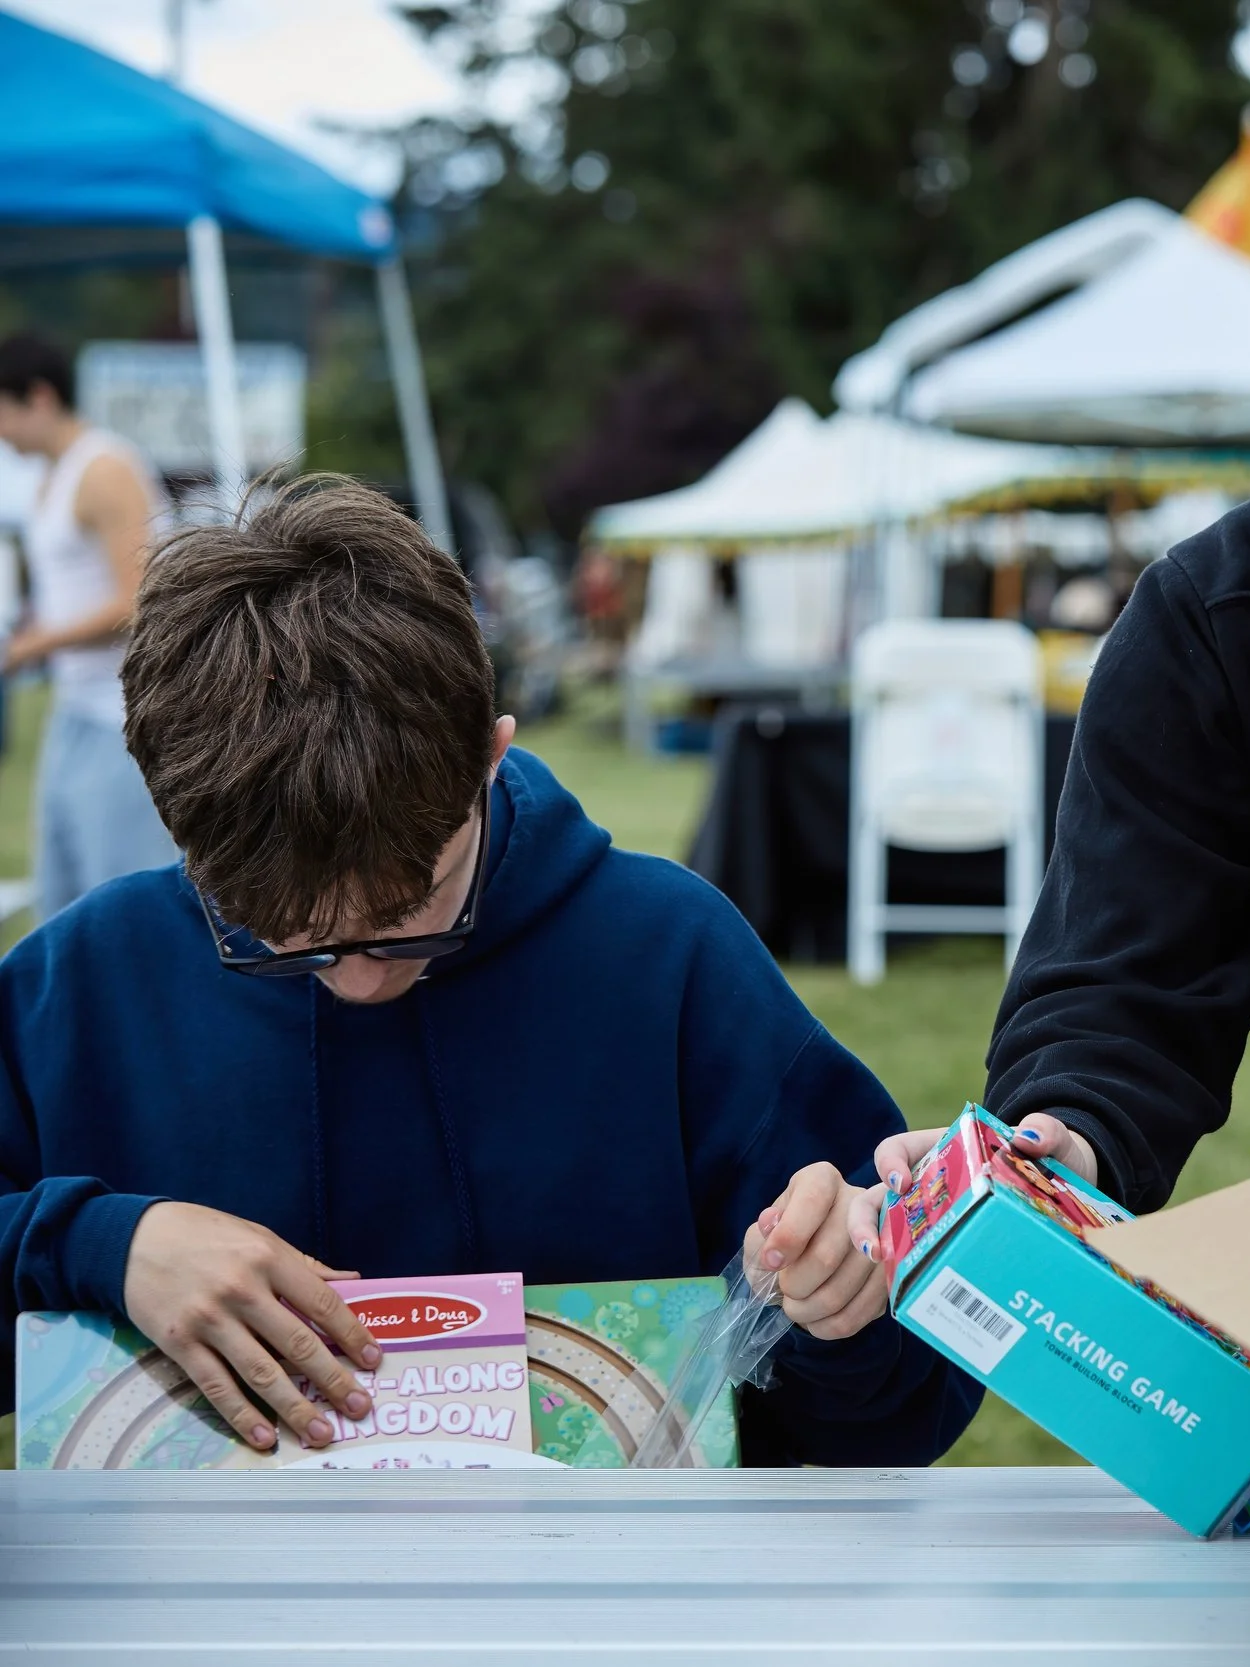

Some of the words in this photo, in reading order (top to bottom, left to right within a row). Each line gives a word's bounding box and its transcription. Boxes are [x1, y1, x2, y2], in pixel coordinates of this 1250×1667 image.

[357, 1311, 406, 1328] lissa
[1008, 1290, 1129, 1382] STACKING
[1130, 1377, 1201, 1434] GAME
[1043, 1340, 1073, 1364] TOWER
[1072, 1360, 1111, 1392] BUILDING
[1111, 1389, 1143, 1414] BLOCKS
[302, 1400, 516, 1449] INGDOM
